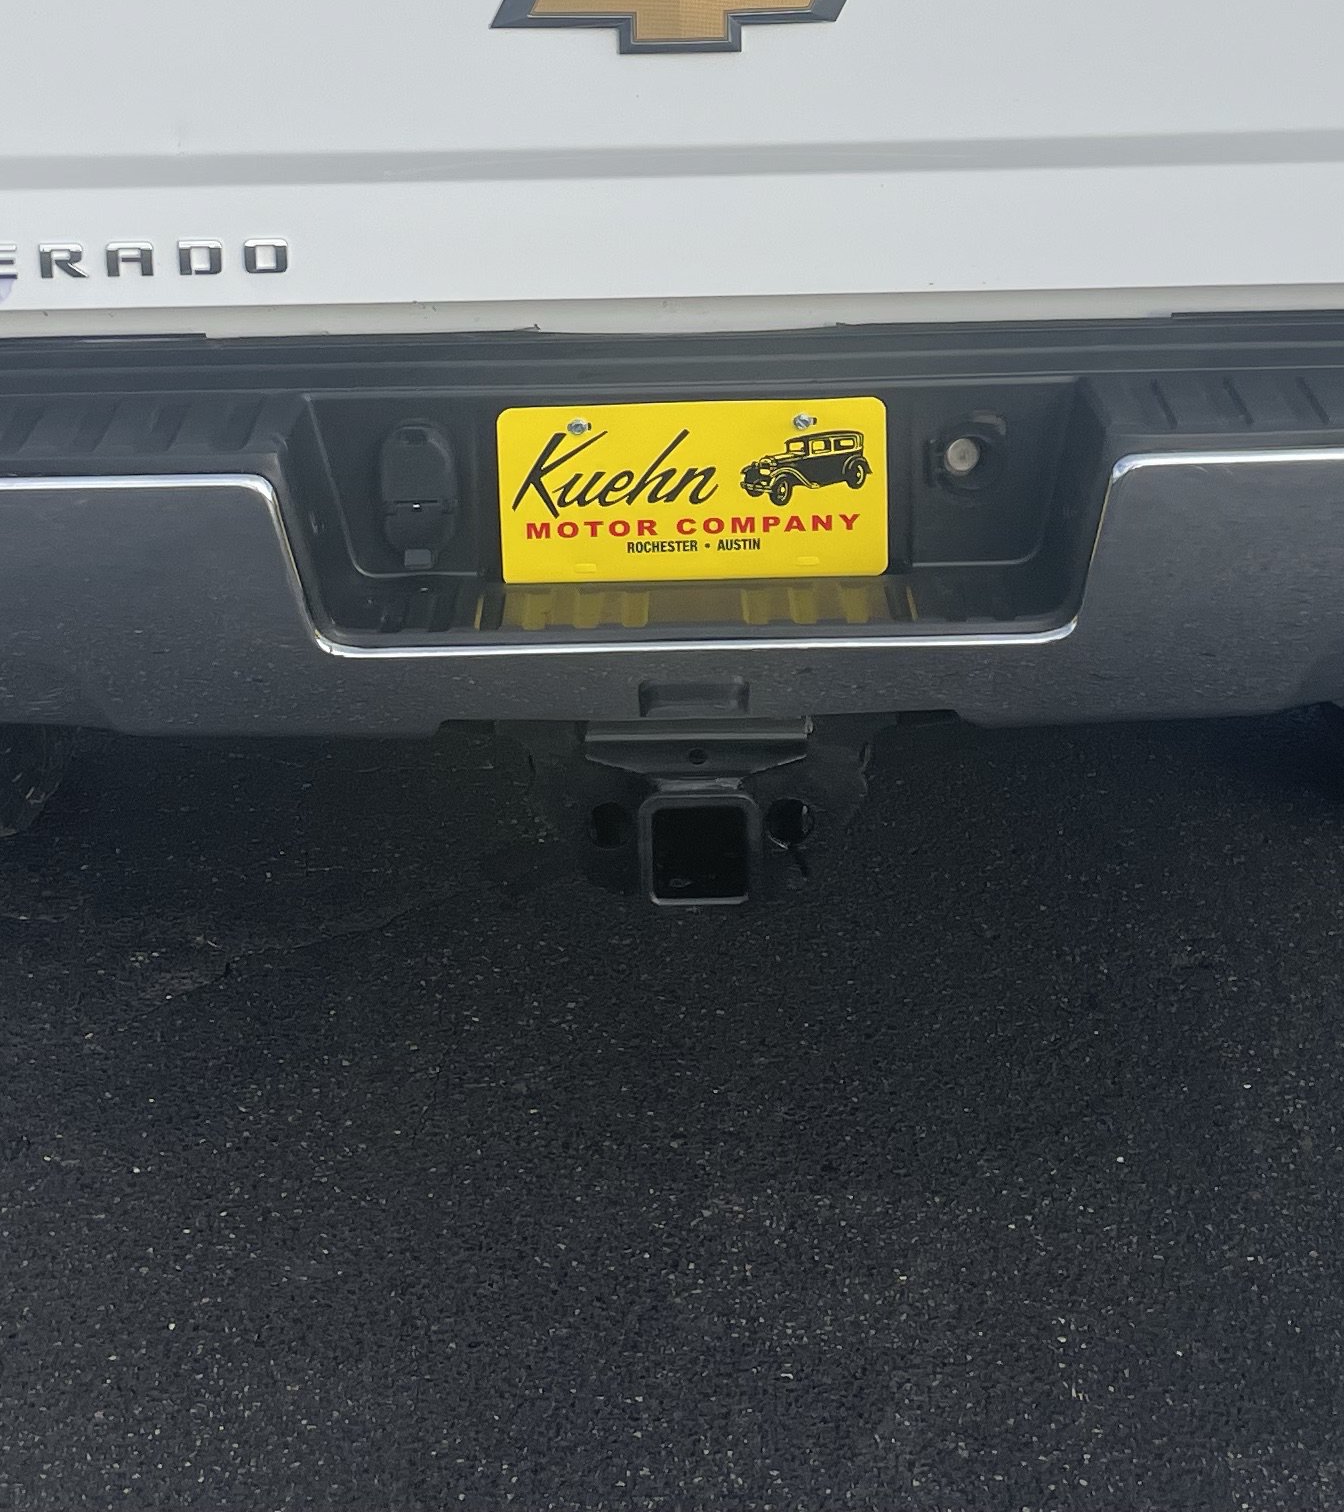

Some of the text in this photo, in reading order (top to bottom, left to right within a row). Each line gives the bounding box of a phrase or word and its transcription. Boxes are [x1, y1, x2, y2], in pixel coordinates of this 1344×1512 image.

[512, 428, 720, 520] Kuehn
[526, 513, 861, 540] MOTOR COMPANY
[627, 537, 762, 554] ROCHESTER AUSTIN
